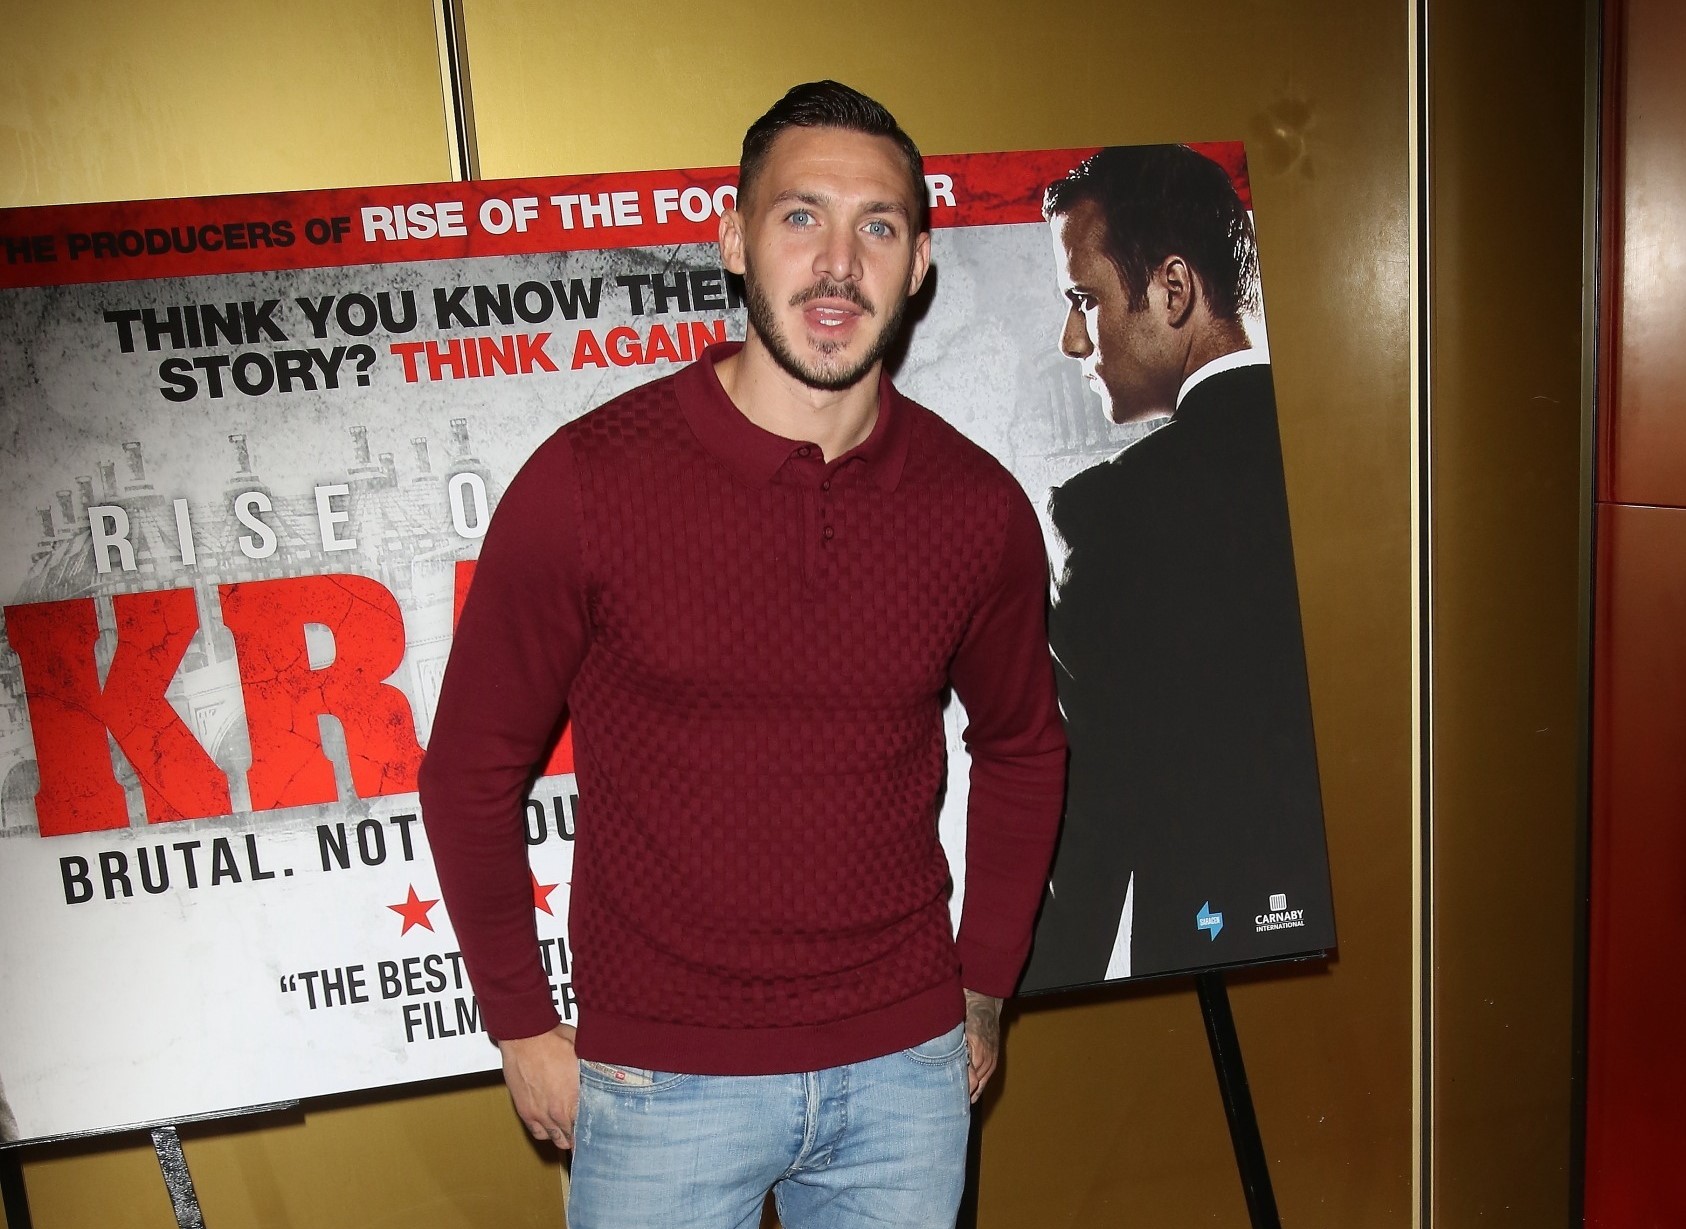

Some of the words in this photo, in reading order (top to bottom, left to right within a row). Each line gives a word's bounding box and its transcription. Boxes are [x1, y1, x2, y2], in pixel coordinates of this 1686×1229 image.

[0, 234, 57, 265] HE
[67, 220, 296, 261] PRODUCERS
[304, 216, 352, 246] OF
[361, 201, 468, 242] RISE
[479, 196, 540, 235] OF
[550, 191, 643, 230] THE
[104, 299, 289, 354] THINK
[295, 292, 418, 338] YOU
[433, 277, 603, 330] KNOW
[158, 343, 377, 402] STORY?
[390, 332, 559, 384] THINK
[571, 320, 727, 371] AGAIN
[88, 484, 358, 574] RISE
[447, 472, 489, 539] O
[59, 832, 295, 906] BRUTAL.
[318, 813, 418, 873] NOT
[1255, 910, 1304, 925] CARNABY
[1256, 921, 1305, 932] INTERNATIONAL
[280, 964, 370, 1010] “THE
[377, 951, 466, 1000] BEST
[402, 996, 488, 1042] FILM
